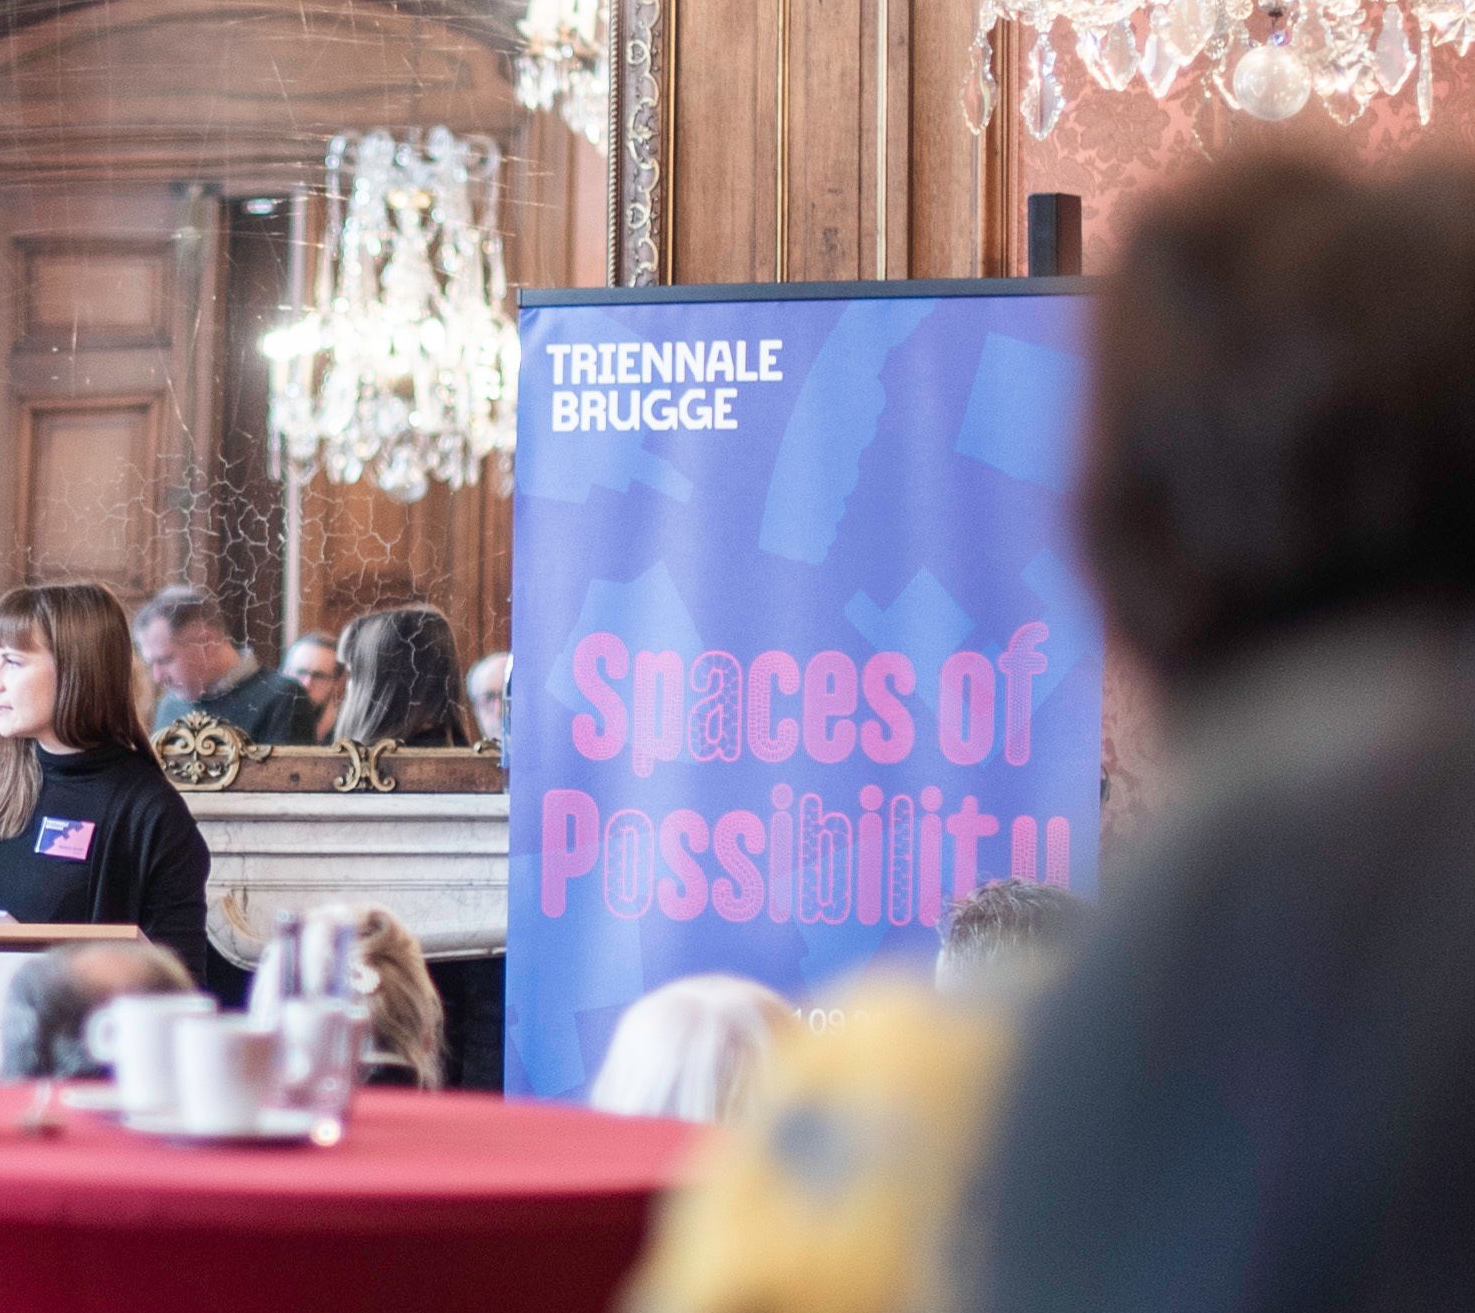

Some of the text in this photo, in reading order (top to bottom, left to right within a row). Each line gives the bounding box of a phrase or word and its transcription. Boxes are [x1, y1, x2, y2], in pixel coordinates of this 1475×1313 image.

[546, 339, 783, 386] TRIENNALE
[552, 388, 738, 433] BRUGGE
[572, 621, 1050, 779] Spaces of
